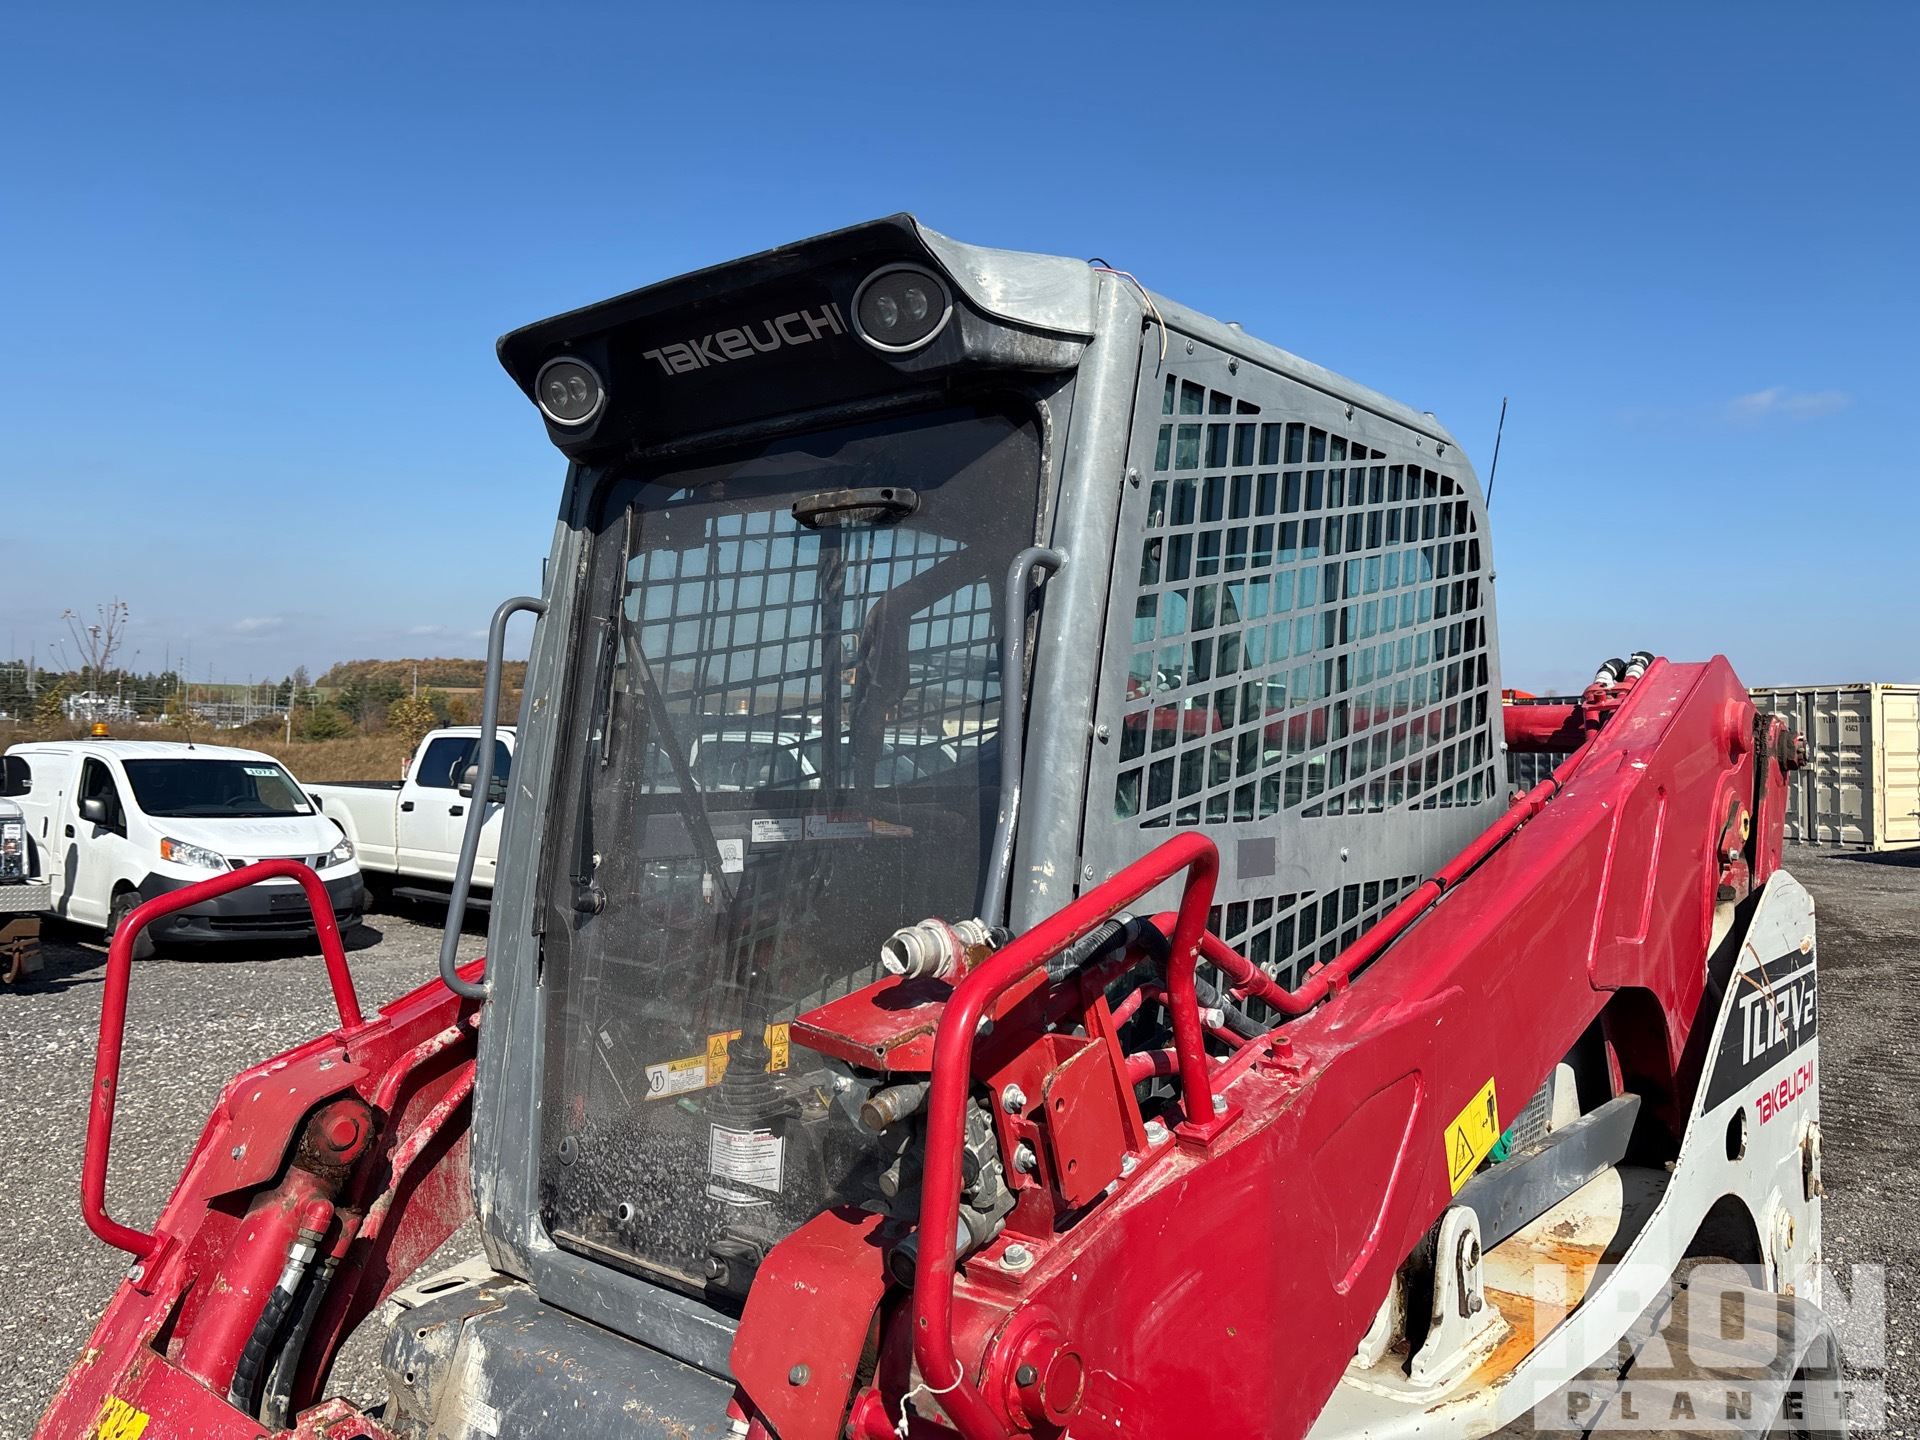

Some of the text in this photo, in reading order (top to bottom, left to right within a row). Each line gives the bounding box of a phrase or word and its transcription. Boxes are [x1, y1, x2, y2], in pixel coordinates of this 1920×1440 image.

[642, 302, 849, 376] TAKEUCHI
[680, 1059, 702, 1069] CAUTION
[1755, 1059, 1814, 1127] TAKEUCHI
